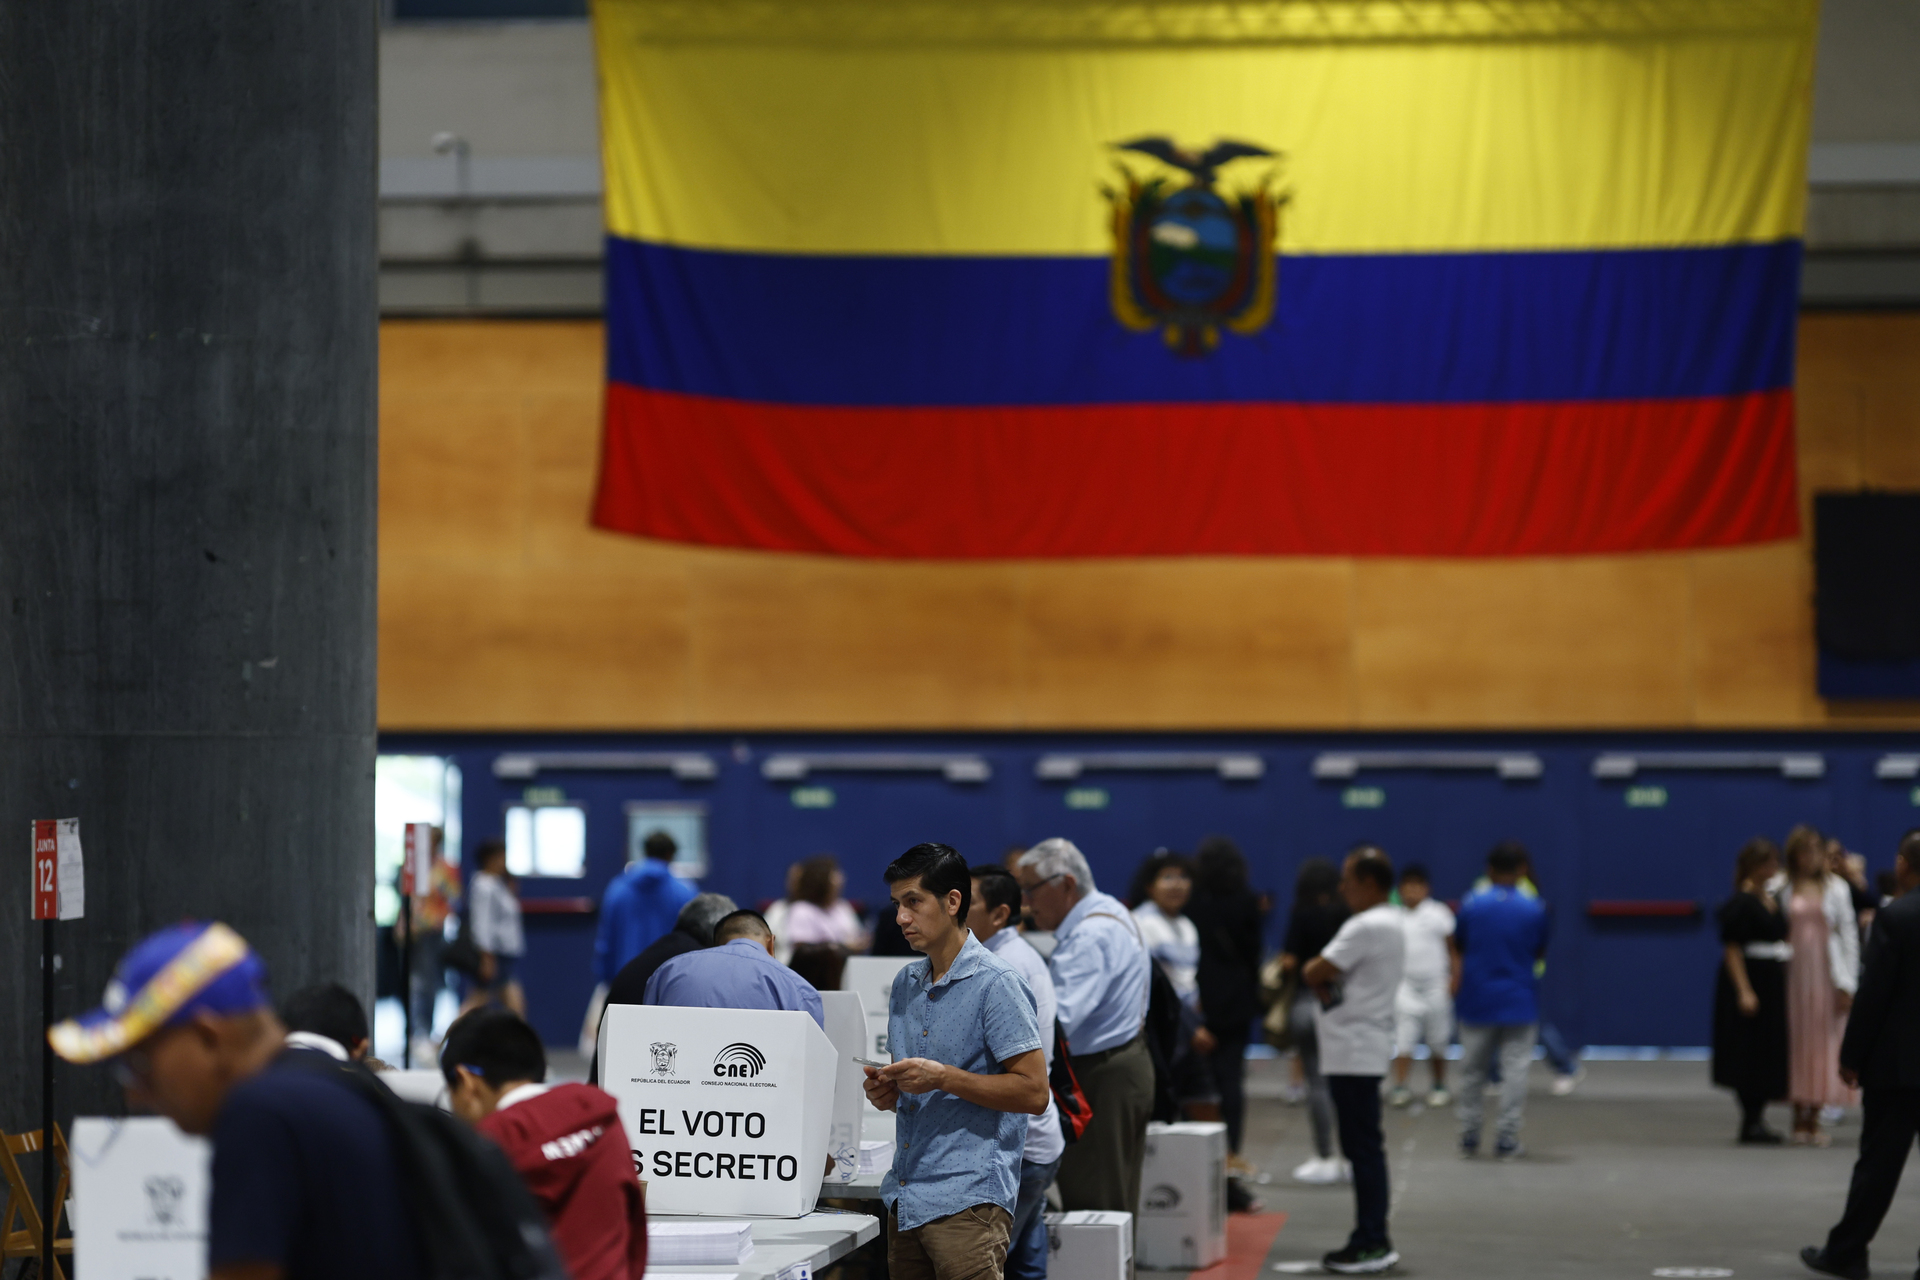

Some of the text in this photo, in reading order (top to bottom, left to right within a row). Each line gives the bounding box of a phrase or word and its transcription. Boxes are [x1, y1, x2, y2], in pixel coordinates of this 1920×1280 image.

[37, 838, 55, 853] JUNTA
[38, 858, 53, 892] 12
[713, 1063, 748, 1078] CNE
[640, 1108, 766, 1139] EL VOTO
[652, 1150, 798, 1182] SECRETO
